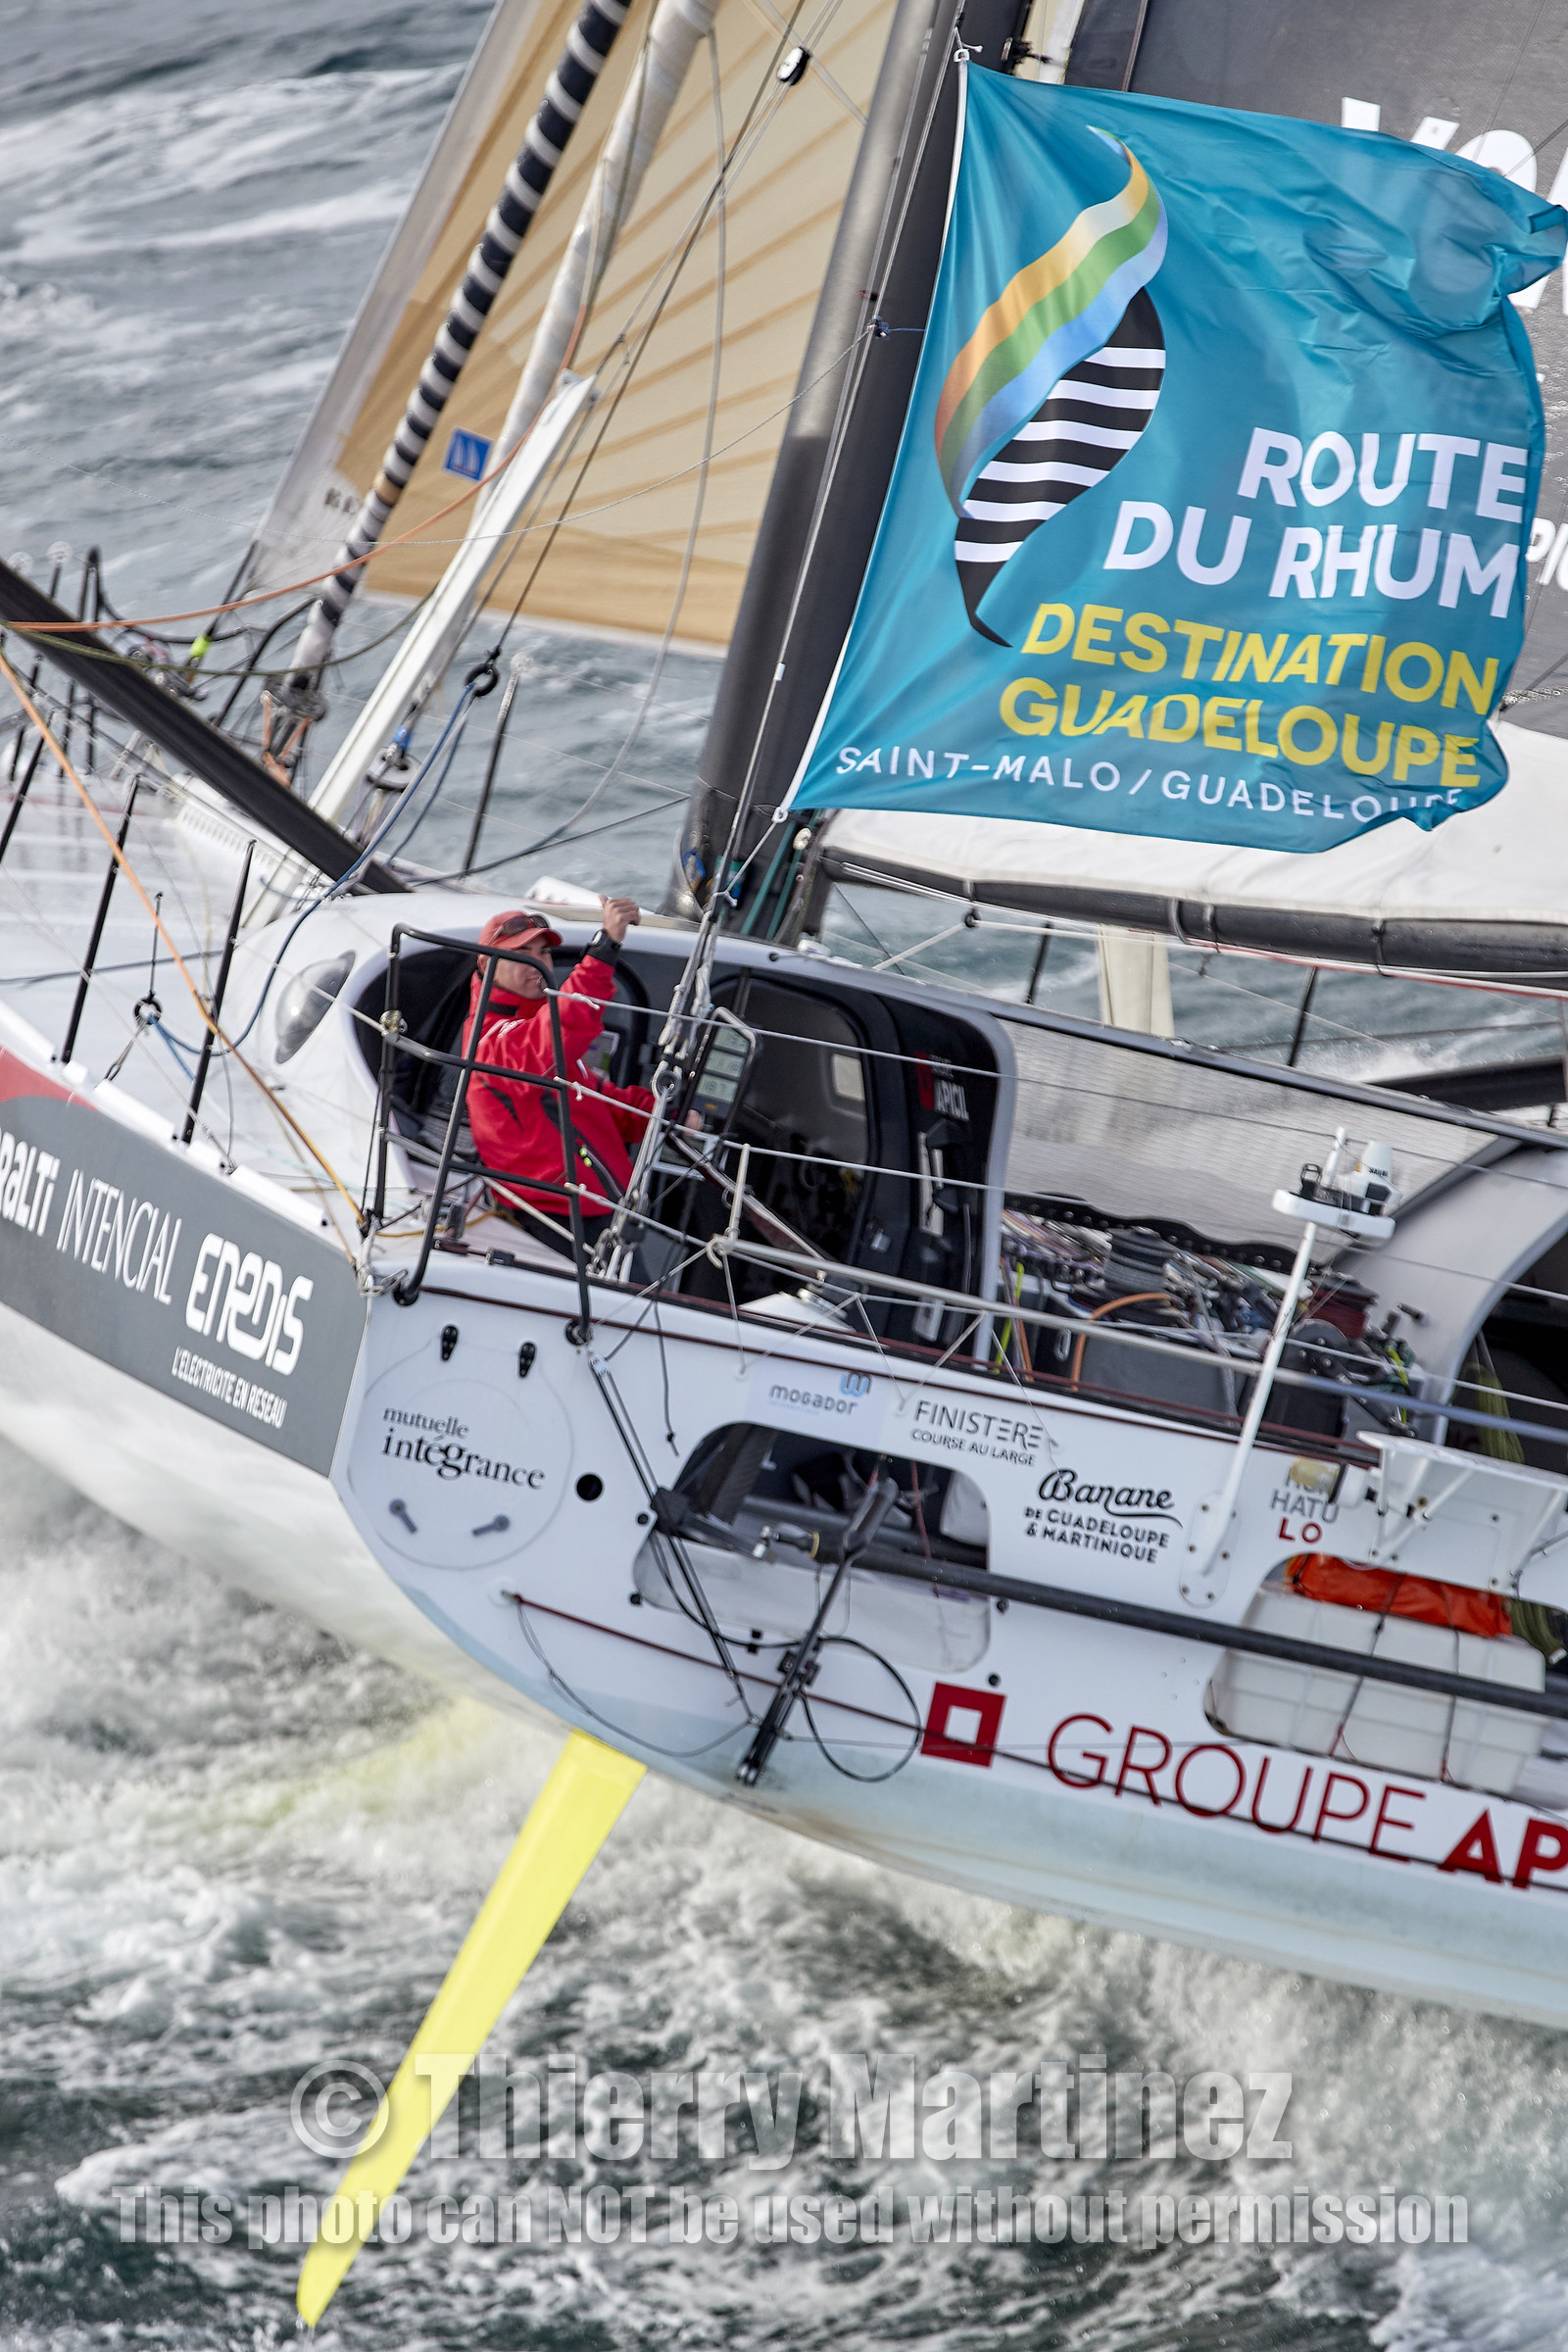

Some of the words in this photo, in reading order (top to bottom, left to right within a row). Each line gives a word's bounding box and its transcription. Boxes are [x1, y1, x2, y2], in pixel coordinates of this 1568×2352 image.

[1238, 427, 1528, 522] ROUTE
[1102, 501, 1252, 585] DU
[1268, 522, 1521, 618] RHUM
[1021, 603, 1499, 715] DESTINATION
[1000, 677, 1482, 788] GUADELOUPE
[57, 1168, 182, 1305] INTENCIAL
[232, 1377, 251, 1411] EN
[382, 1407, 469, 1439] mutuelle
[381, 1427, 546, 1490] intégrance
[911, 1429, 966, 1449] COURSE
[969, 1443, 990, 1456] AU
[992, 1446, 1036, 1466] LARGE
[1025, 1506, 1043, 1519] DE
[1039, 1469, 1183, 1528] Banane
[1270, 1488, 1340, 1524] HATU
[1026, 1522, 1037, 1537] &
[1043, 1526, 1158, 1564] MARTINIQUE
[1047, 1713, 1427, 1863] GROUPE
